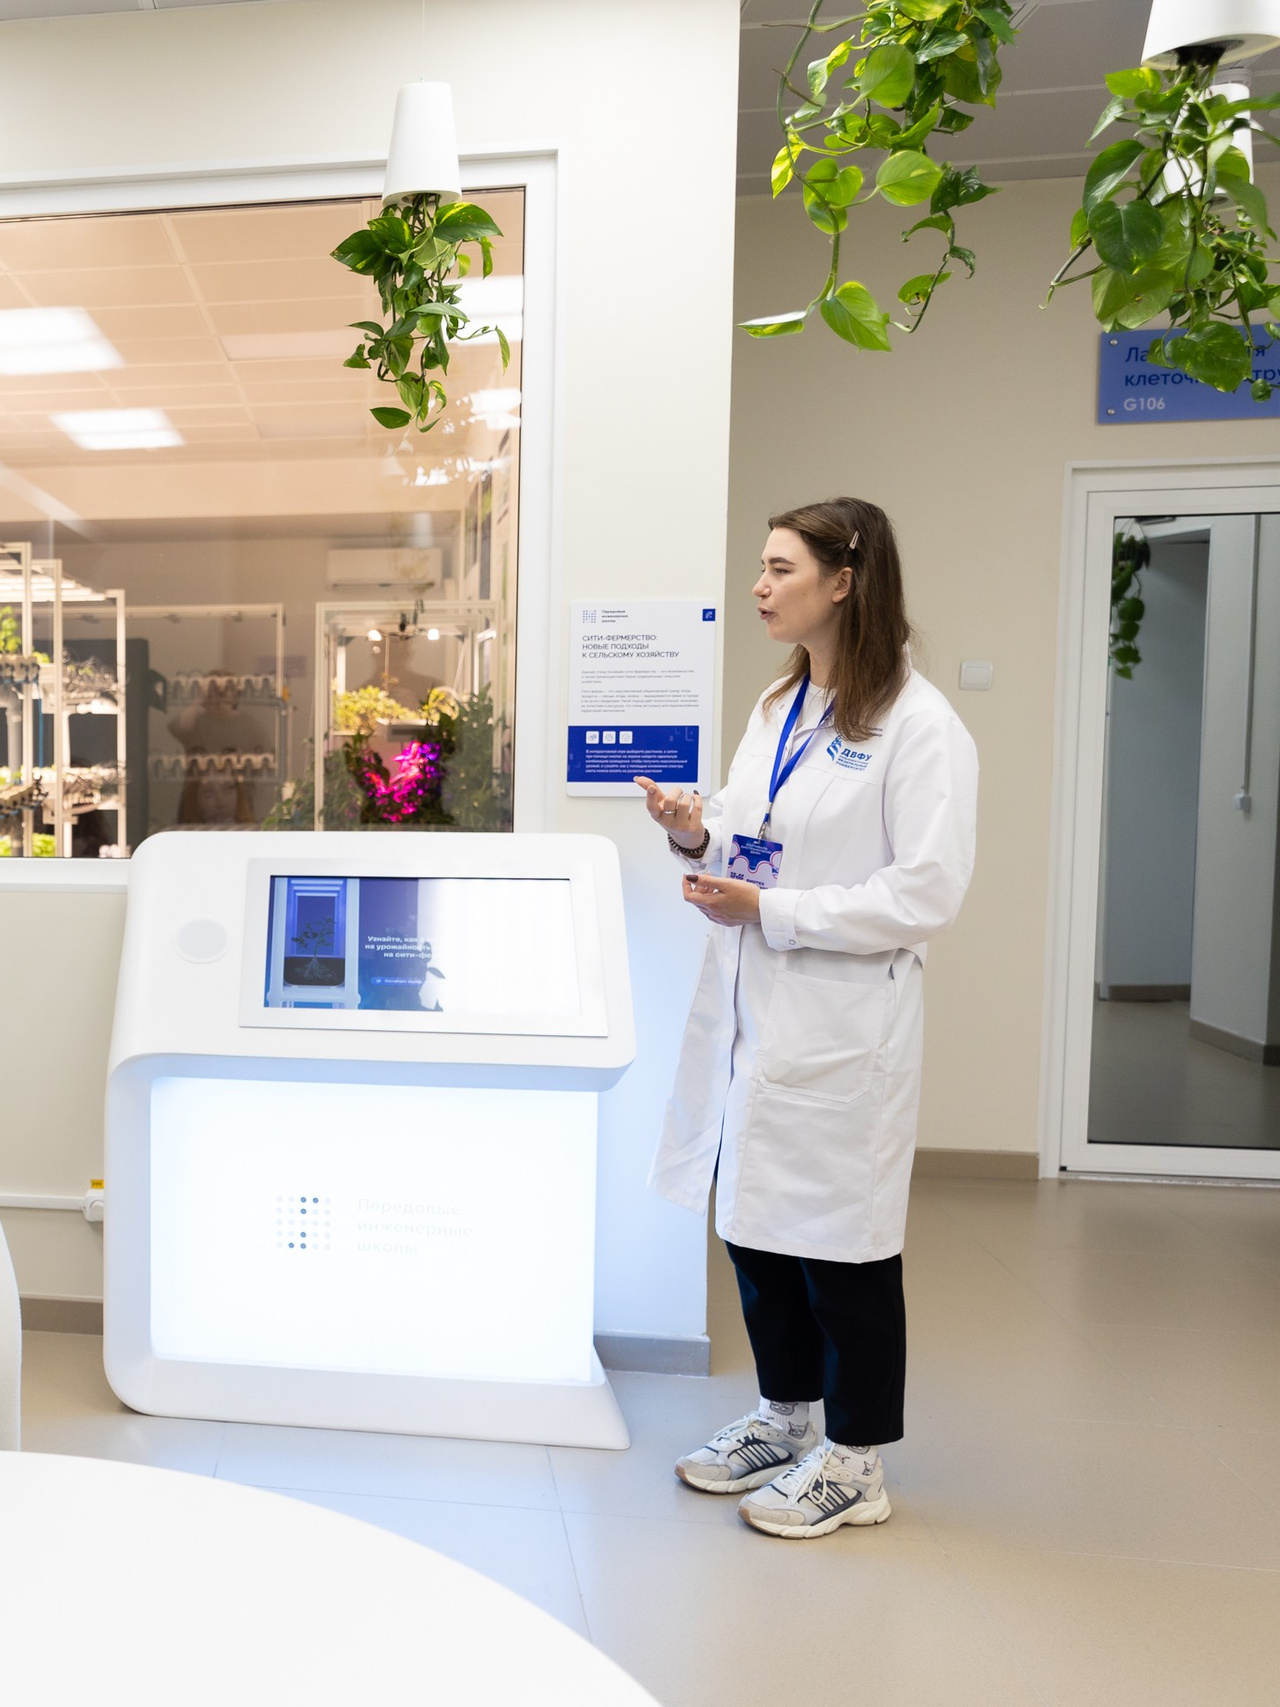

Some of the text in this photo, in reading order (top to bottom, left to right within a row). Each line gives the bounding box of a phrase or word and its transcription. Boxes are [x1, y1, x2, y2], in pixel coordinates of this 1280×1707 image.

[1123, 397, 1165, 411] G106
[588, 651, 634, 659] СЕЛЬСКОМУ
[635, 650, 680, 658] ХОЗЯЙСТВУ
[840, 748, 873, 762] ДВФУ
[367, 935, 403, 943] Узнайте,
[357, 1198, 461, 1215] Передовые
[357, 1221, 473, 1238] инженерные
[357, 1242, 418, 1255] школы
